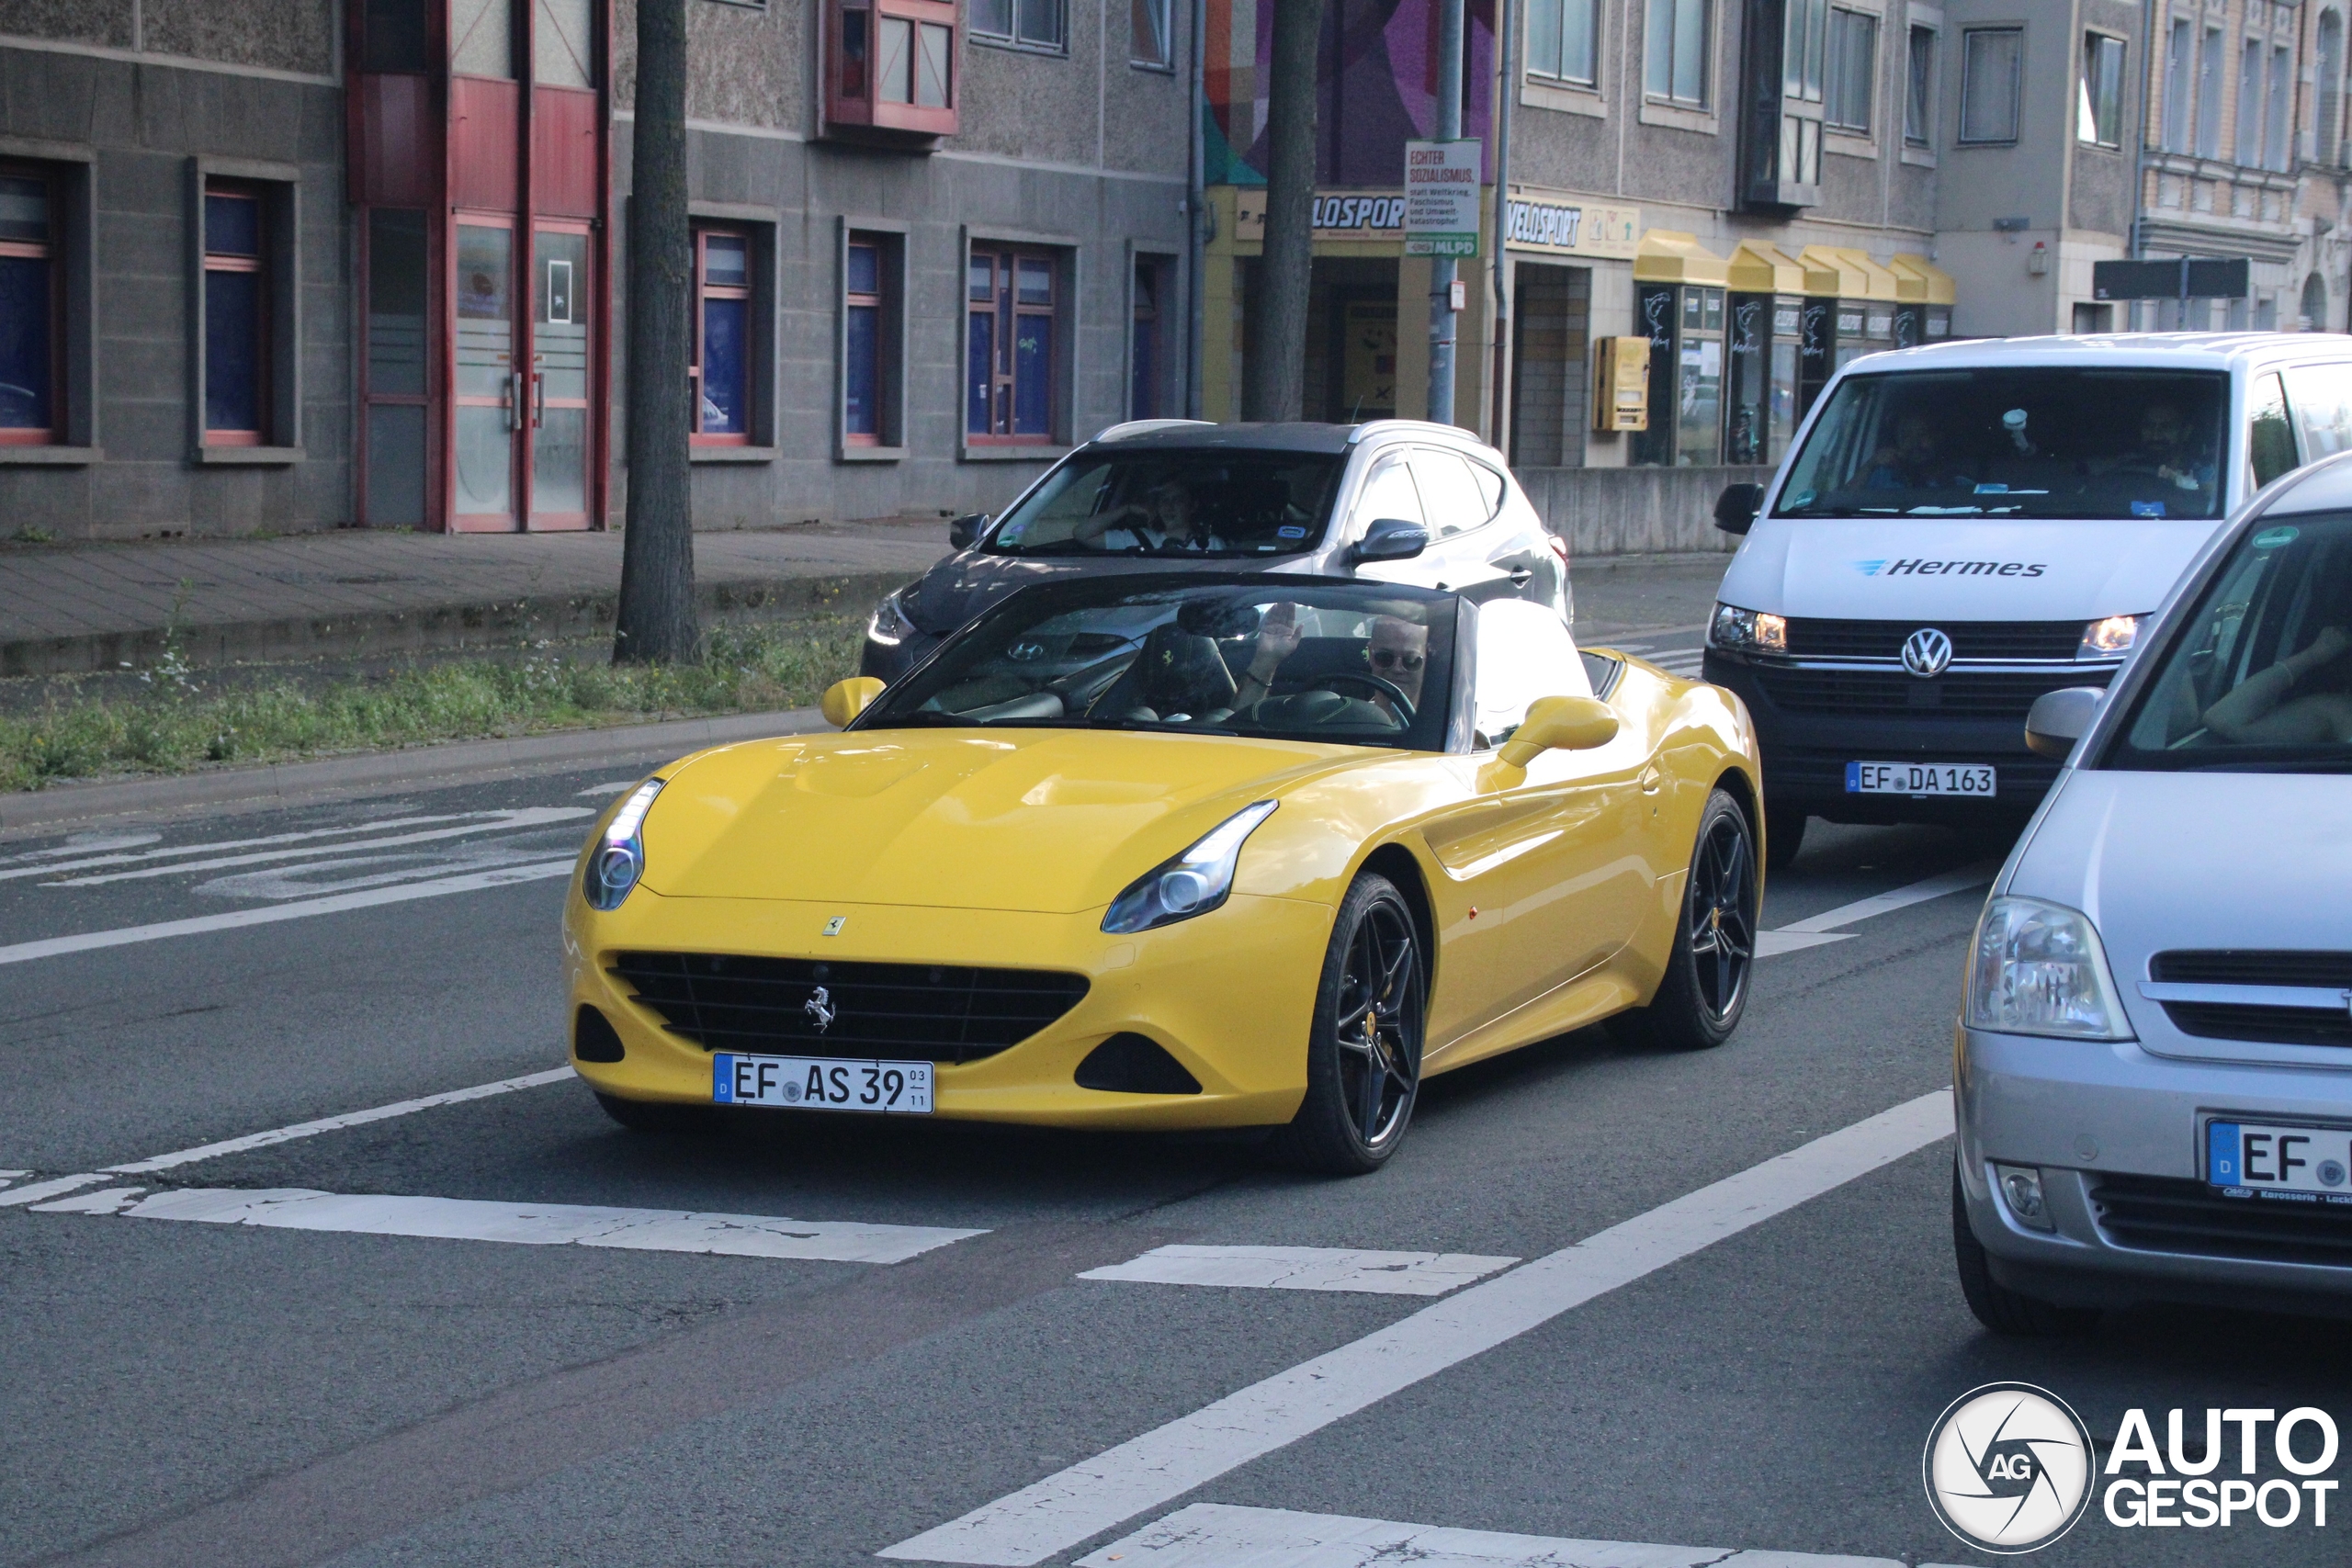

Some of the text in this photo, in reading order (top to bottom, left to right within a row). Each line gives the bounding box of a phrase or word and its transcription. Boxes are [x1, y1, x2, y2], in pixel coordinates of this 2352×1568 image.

[1410, 151, 1444, 164] ECHTER
[1410, 168, 1475, 185] SOZIALISMUS,
[1312, 197, 1406, 229] LOSPOR
[1410, 218, 1459, 226] katastrophe!
[1507, 199, 1581, 247] VELOSPORT
[1434, 242, 1475, 254] MLPD
[1887, 558, 2048, 577] Hermes
[1861, 766, 1991, 792] EF DA 163
[910, 1070, 925, 1081] 03
[719, 1083, 728, 1094] D
[735, 1062, 904, 1105] EF AS 39
[910, 1095, 924, 1106] 11
[2244, 1133, 2311, 1181] EF
[2220, 1160, 2231, 1173] D
[2260, 1190, 2316, 1201] Karosserie
